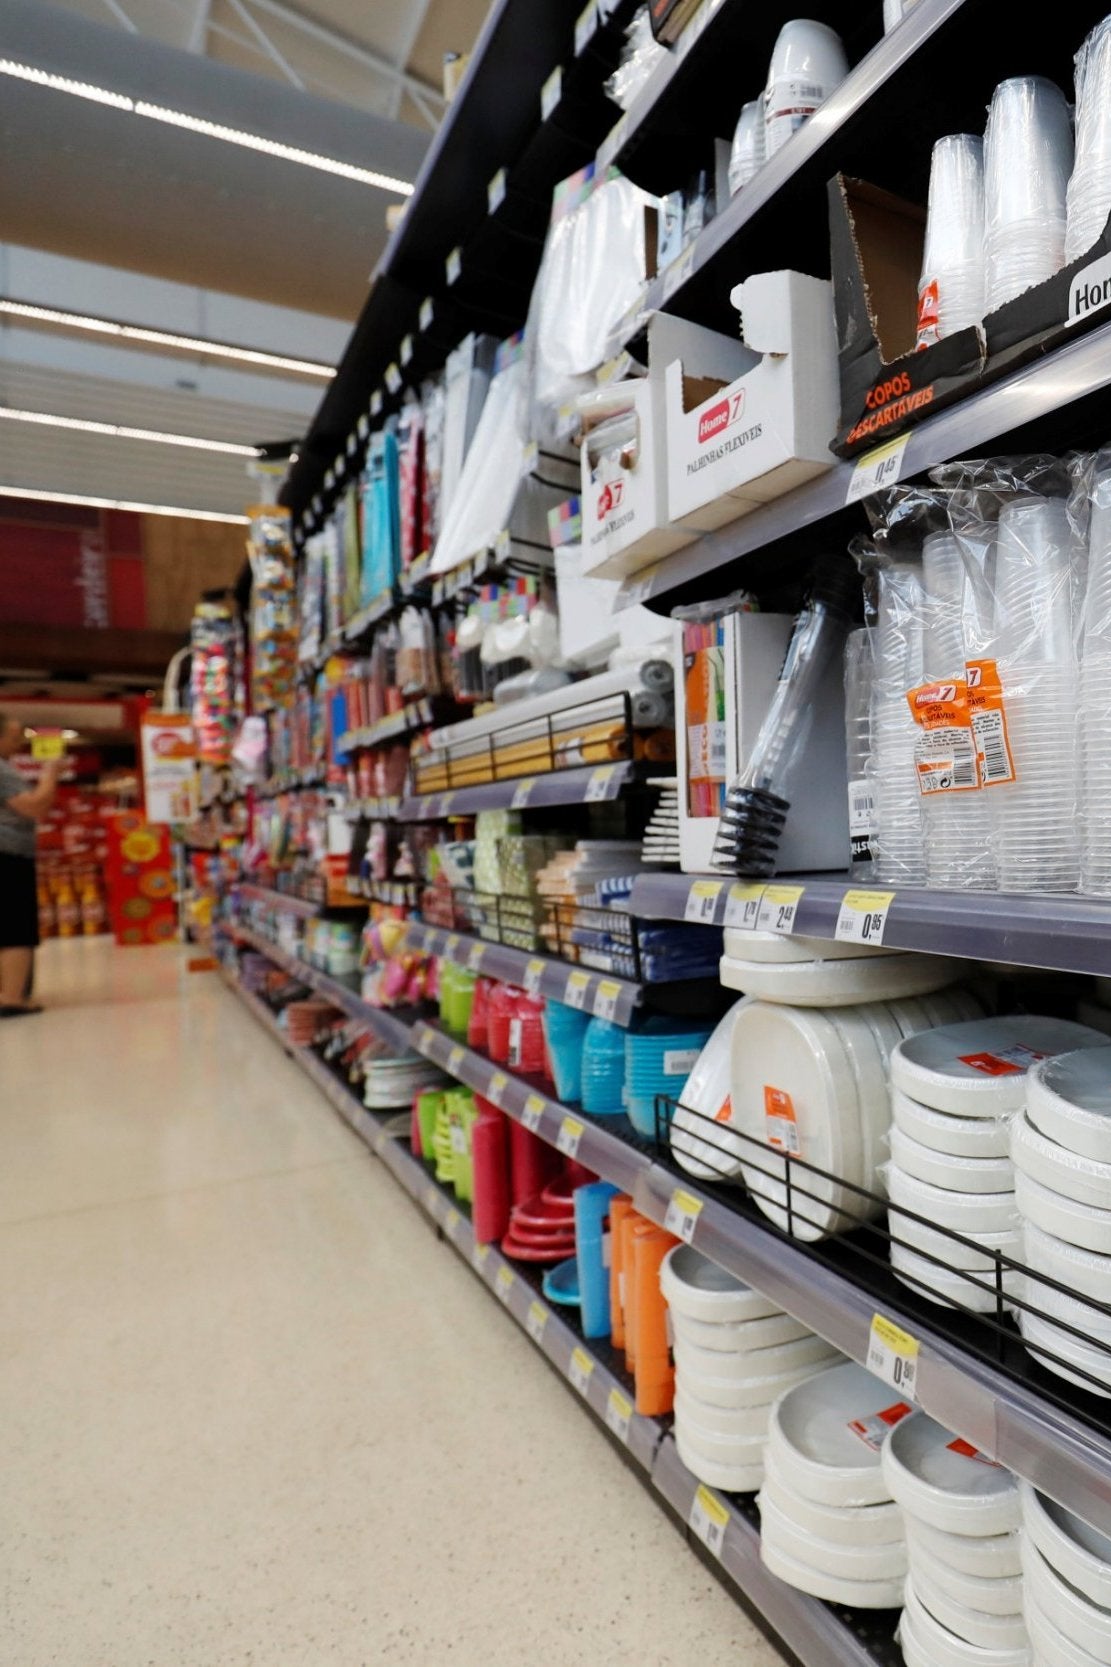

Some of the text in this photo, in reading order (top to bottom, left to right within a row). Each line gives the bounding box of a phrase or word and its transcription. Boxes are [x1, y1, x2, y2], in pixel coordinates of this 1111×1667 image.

[865, 371, 912, 409] COPOS
[700, 393, 742, 436] Home 7
[969, 669, 979, 686] 7
[940, 687, 953, 701] 7
